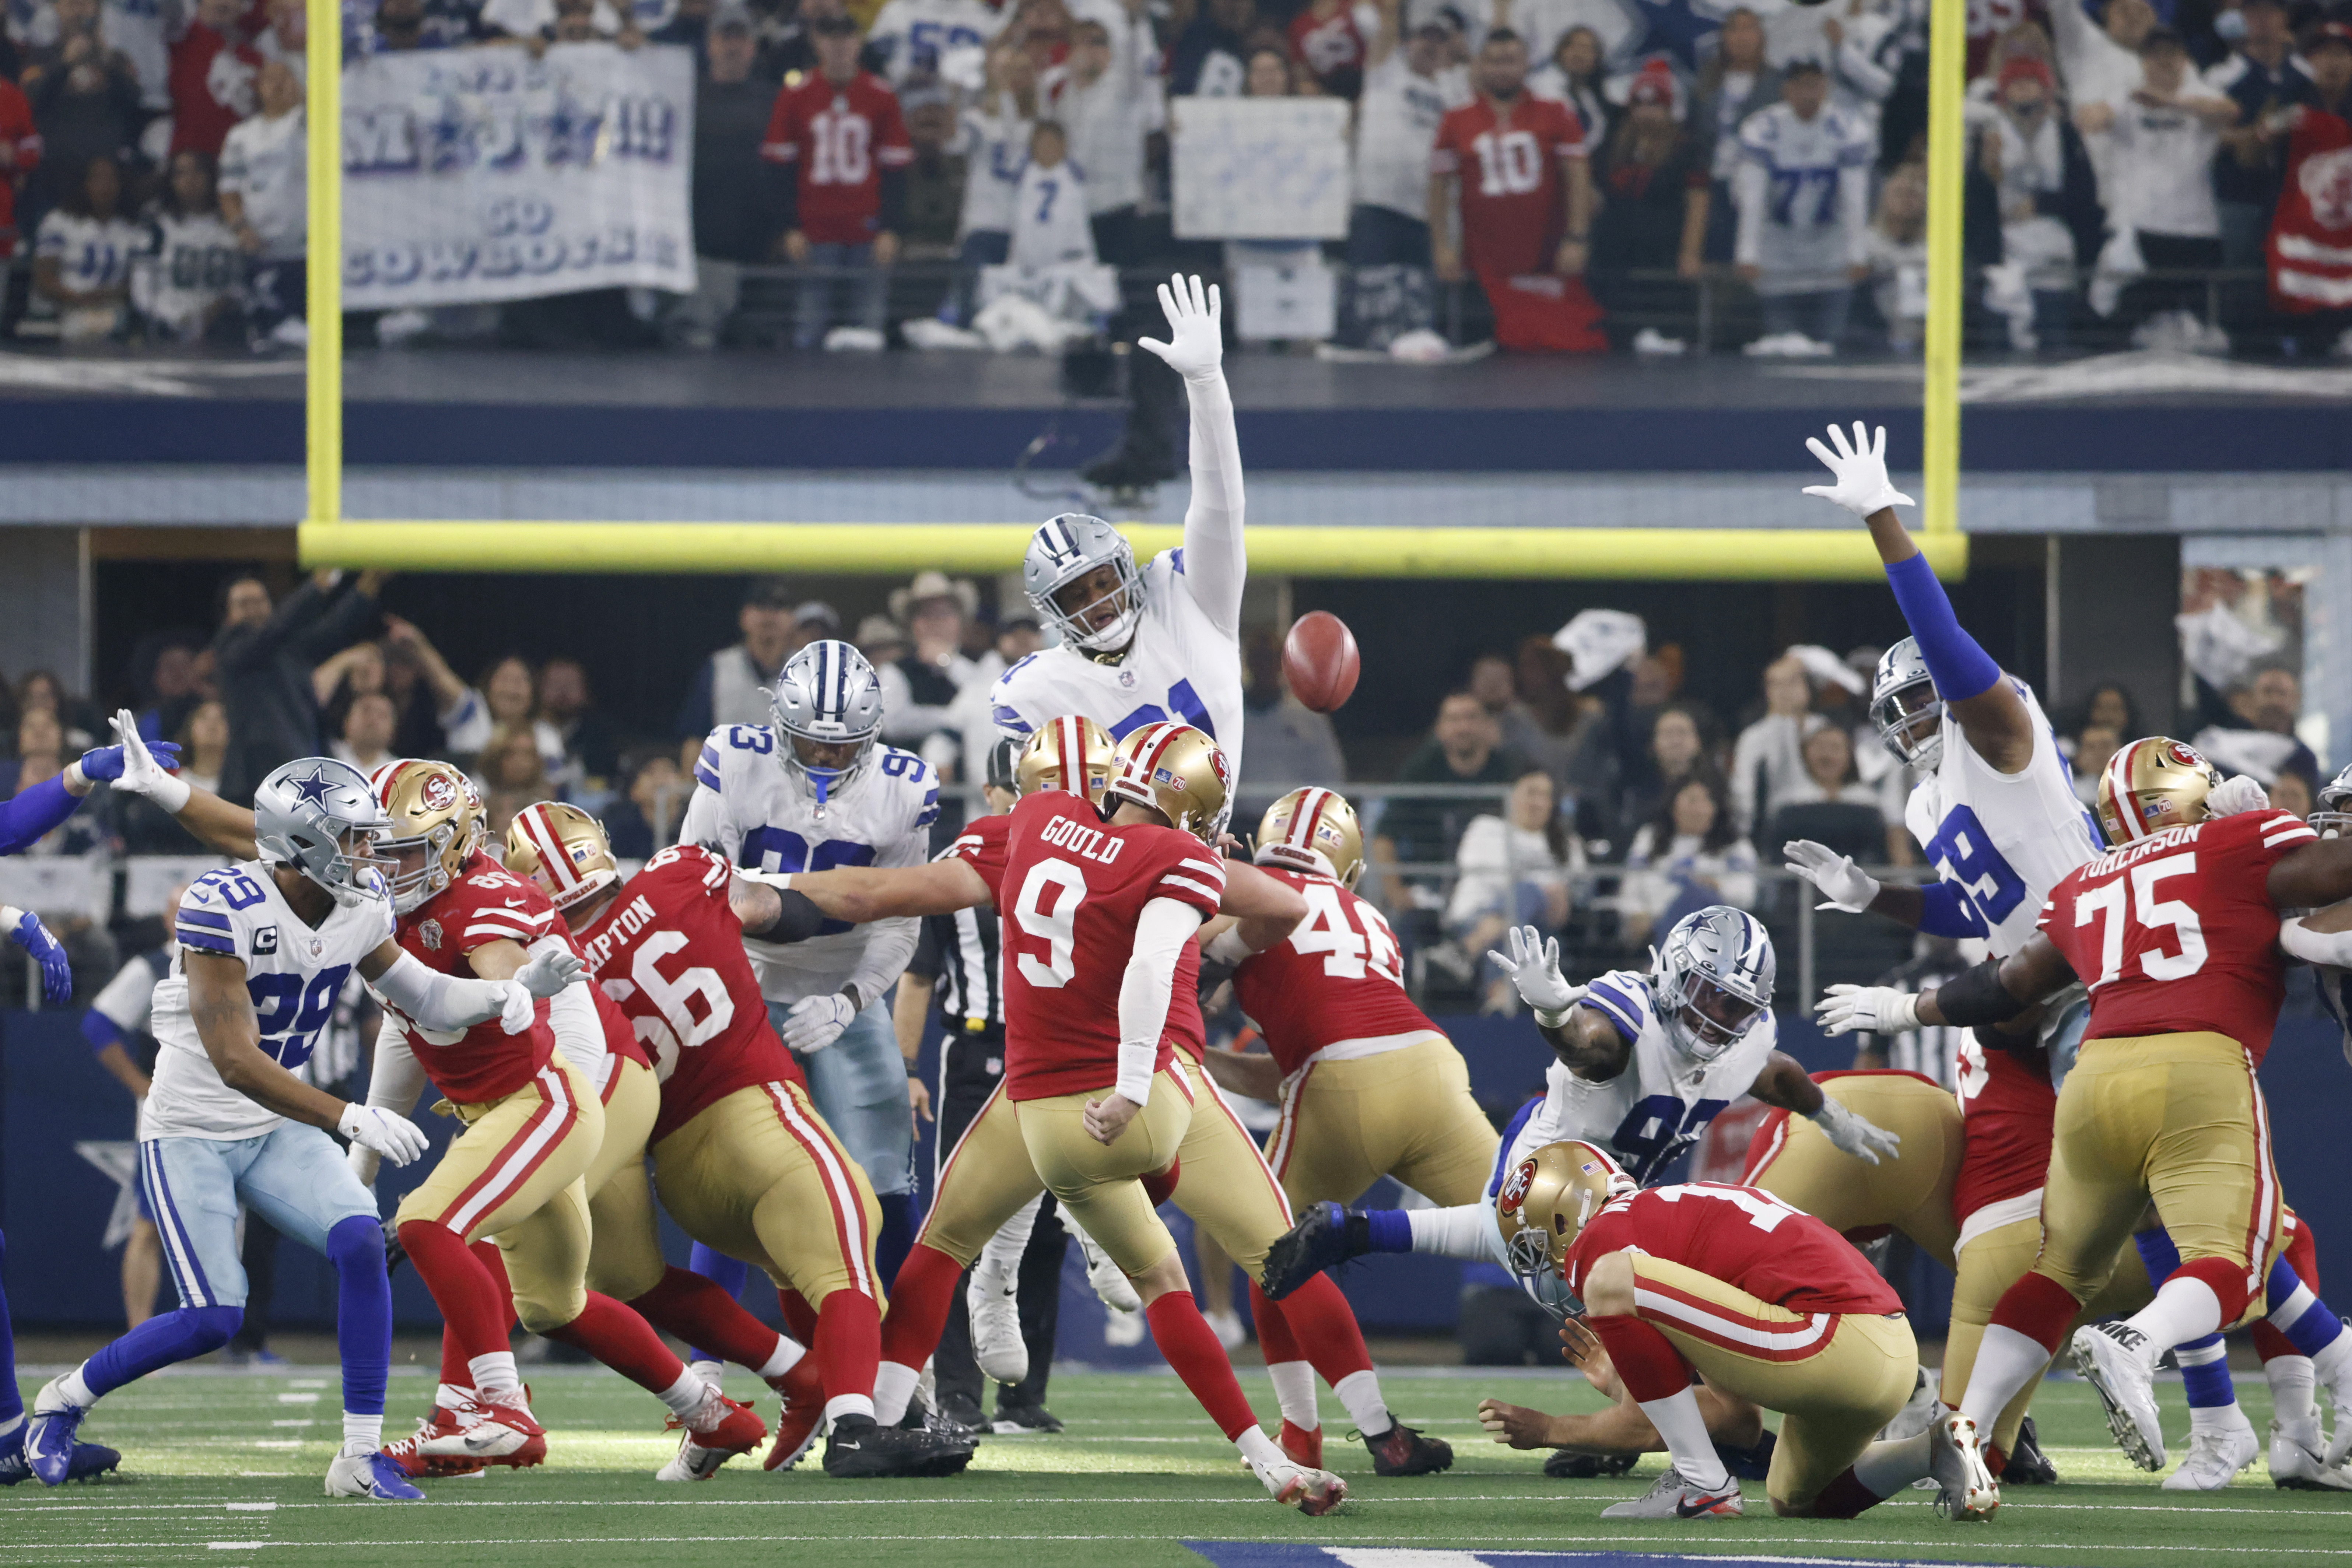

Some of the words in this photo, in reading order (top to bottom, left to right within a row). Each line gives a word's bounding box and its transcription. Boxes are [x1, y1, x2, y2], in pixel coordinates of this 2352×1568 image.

[810, 112, 872, 185] 10
[1473, 129, 1543, 197] 10
[1036, 179, 1058, 223] 7
[1769, 167, 1840, 226] 77
[1174, 777, 1185, 789] 70
[2160, 800, 2171, 811] 70
[1040, 815, 1125, 864] GOULD
[2078, 823, 2205, 882] TOMLINSON
[256, 927, 277, 948] C
[583, 894, 656, 974] MPTON
[1014, 857, 1088, 988] 9
[2075, 851, 2209, 995] 75
[246, 962, 352, 1070] 29
[1654, 1181, 1812, 1233] 1
